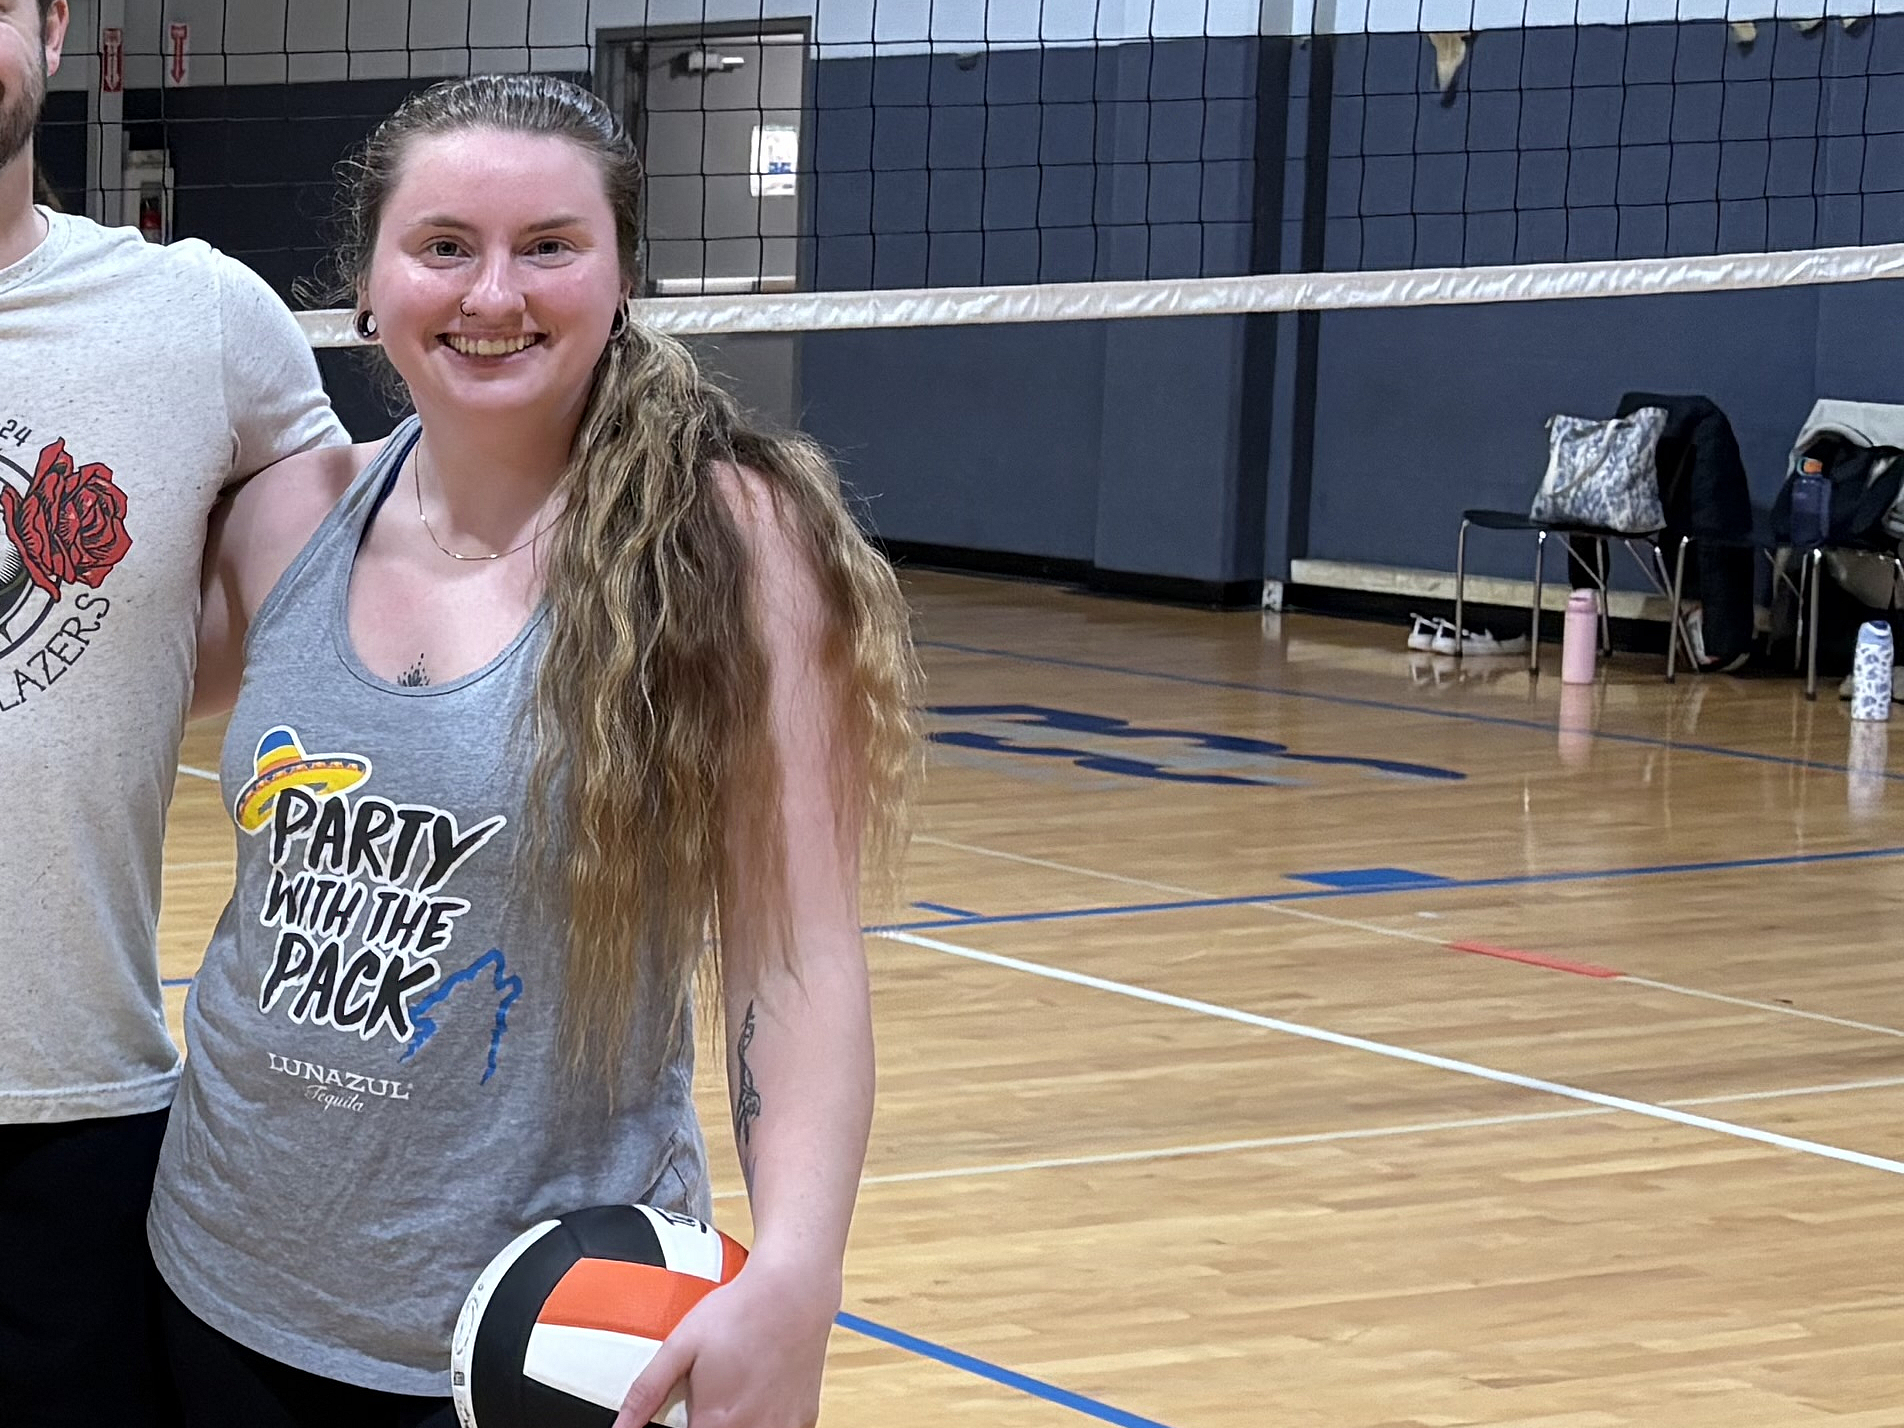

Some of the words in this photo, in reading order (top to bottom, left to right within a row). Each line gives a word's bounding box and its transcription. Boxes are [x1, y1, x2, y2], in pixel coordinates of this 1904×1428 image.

[270, 786, 506, 894] PARTY
[265, 870, 364, 938] WITH
[366, 890, 471, 953] THE
[260, 930, 437, 1040] PACK
[266, 1051, 411, 1101] LUNAZUL
[304, 1084, 365, 1114] Tequila
